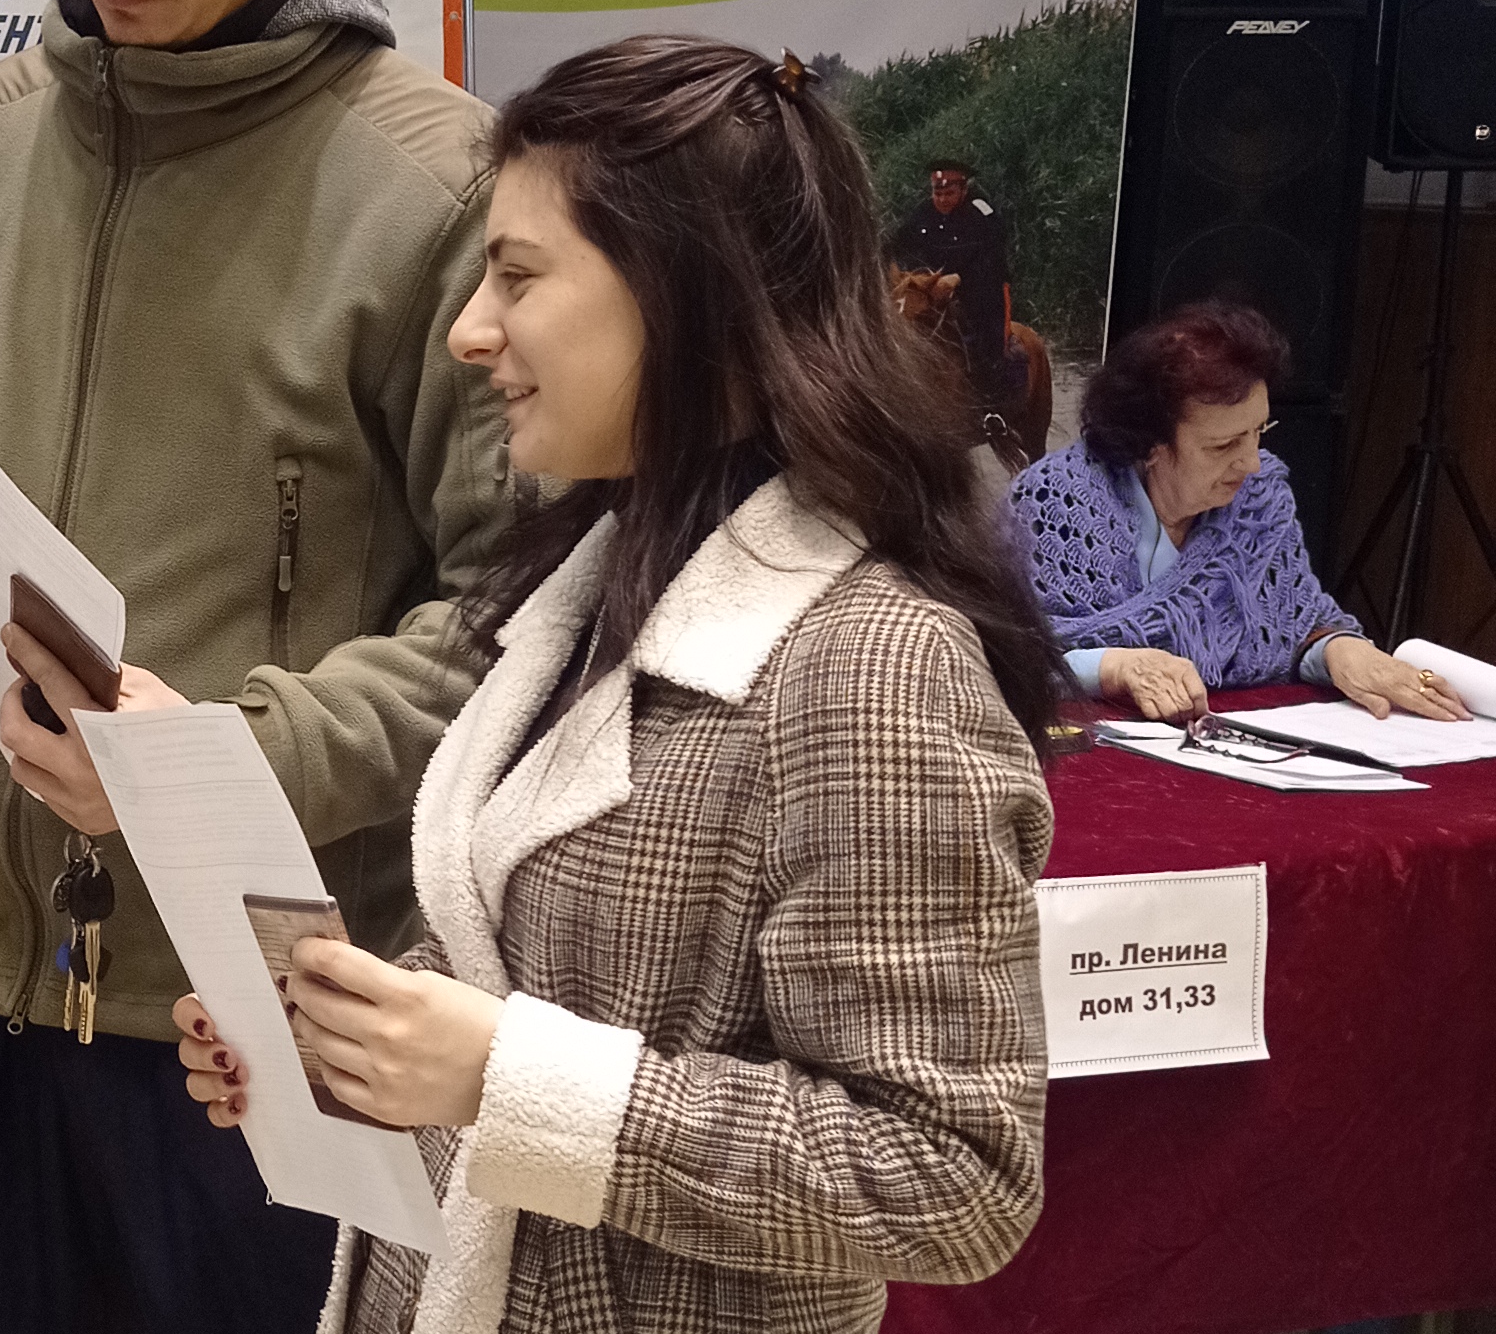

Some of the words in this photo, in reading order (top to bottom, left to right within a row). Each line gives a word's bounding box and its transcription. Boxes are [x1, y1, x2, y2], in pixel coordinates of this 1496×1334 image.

[1226, 19, 1310, 35] PEAVEY
[1070, 947, 1112, 973] пр.
[1119, 940, 1228, 966] Ленина
[1079, 992, 1133, 1022] дом
[1143, 984, 1216, 1015] 31,33
